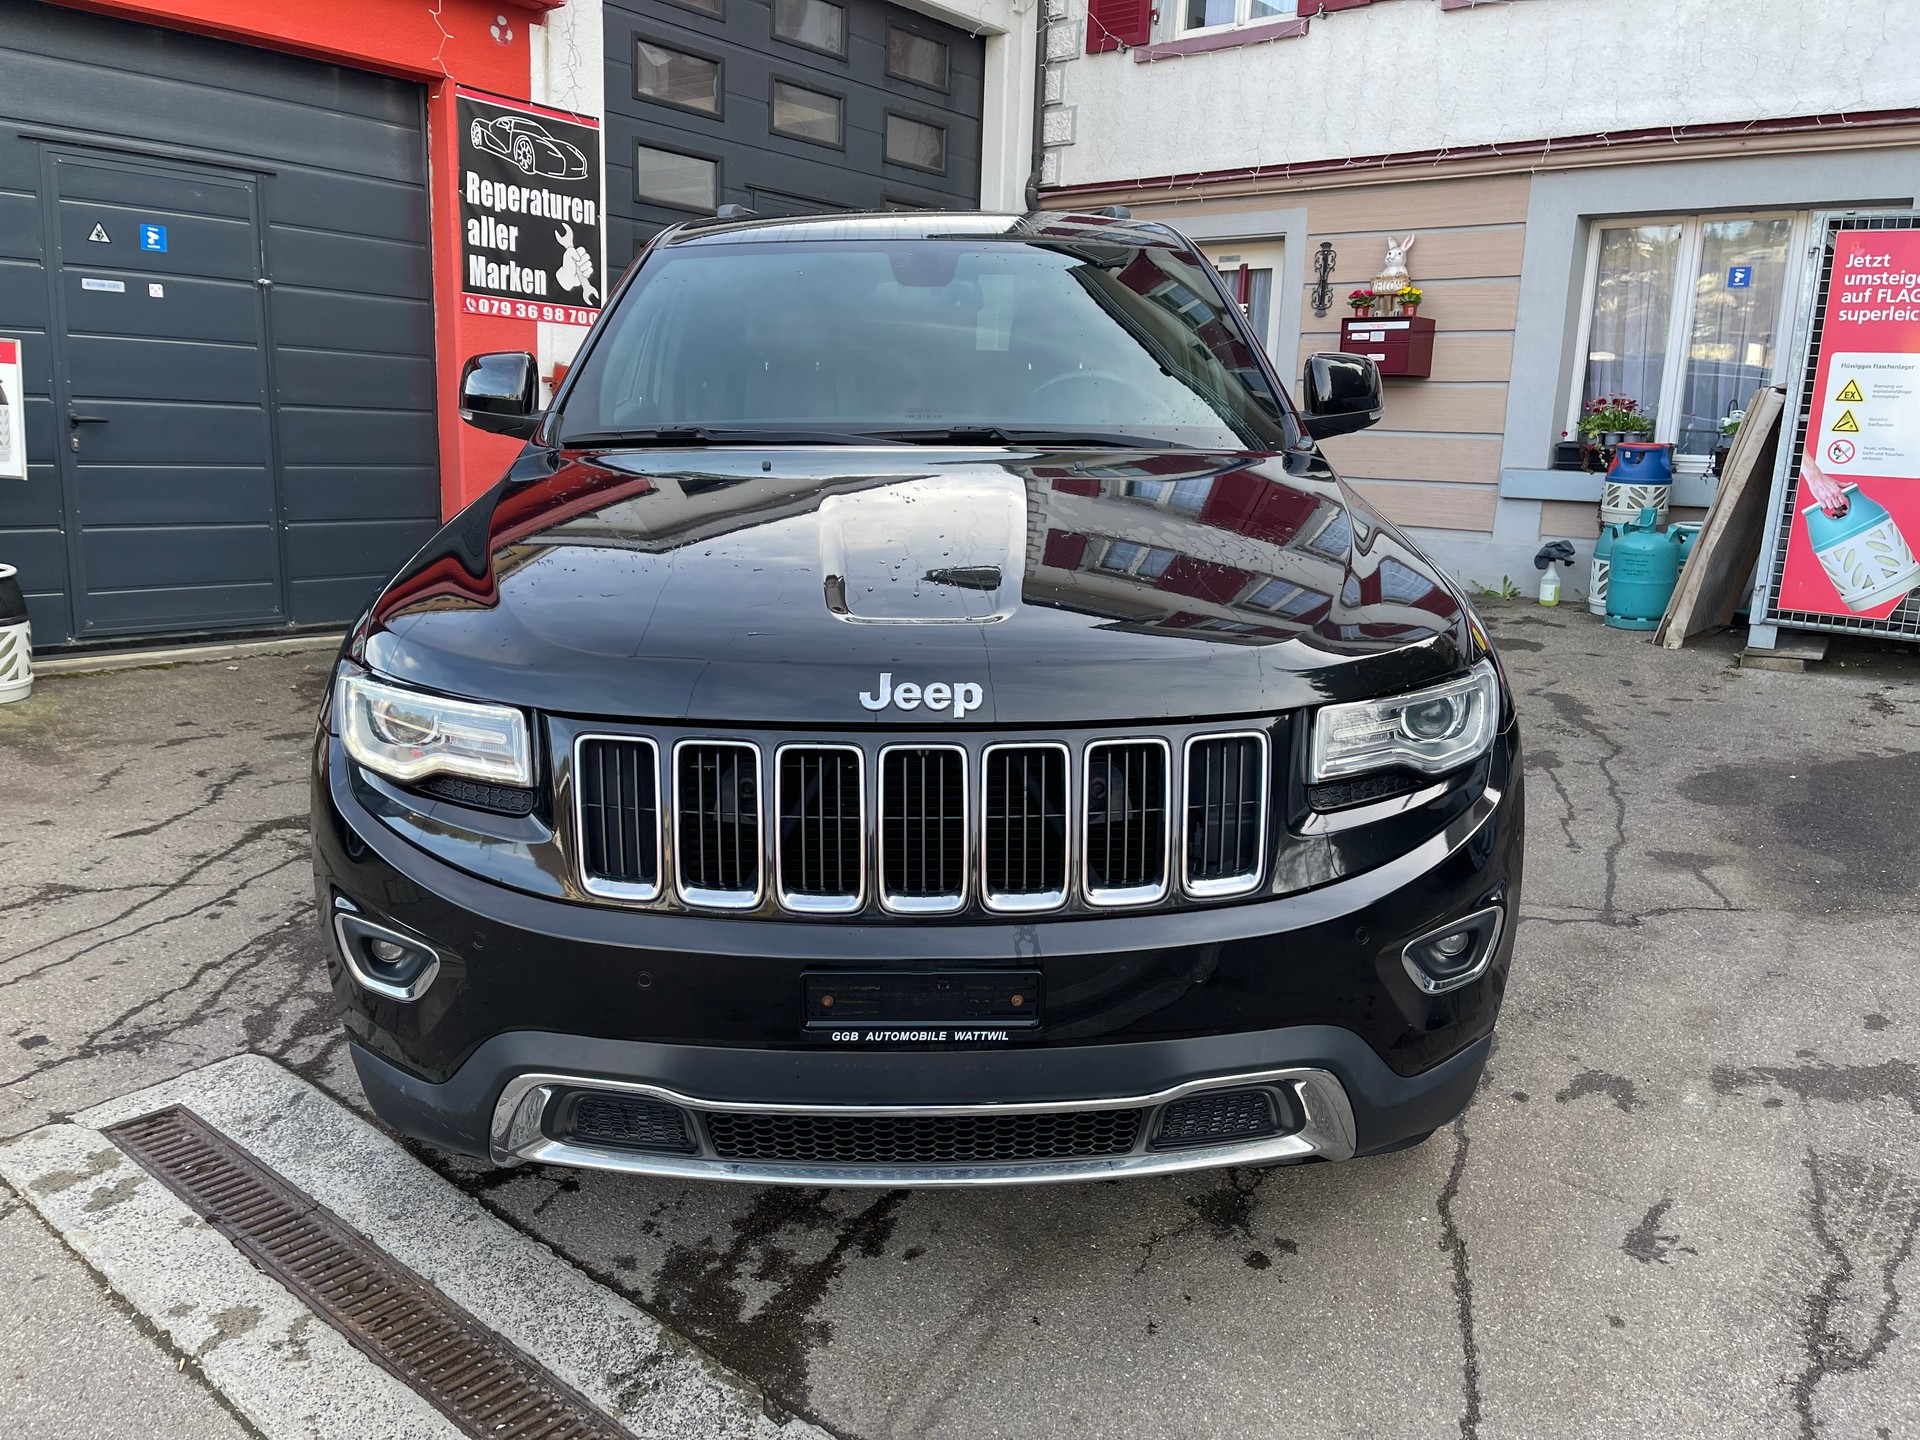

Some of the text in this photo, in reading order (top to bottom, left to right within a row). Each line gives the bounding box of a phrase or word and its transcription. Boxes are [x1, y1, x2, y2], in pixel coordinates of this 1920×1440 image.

[466, 170, 596, 225] Reperaturen
[467, 215, 518, 251] aller
[1845, 253, 1891, 268] Jetzt
[469, 254, 547, 296] Marken
[1841, 288, 1872, 303] auf
[478, 298, 598, 325] 079 36 98 700
[1872, 363, 1915, 371] Flaschenlager
[1844, 391, 1856, 399] EX
[859, 672, 983, 719] Jeep
[831, 1031, 1009, 1042] GGB AUTOMOBILE WATTWIL
